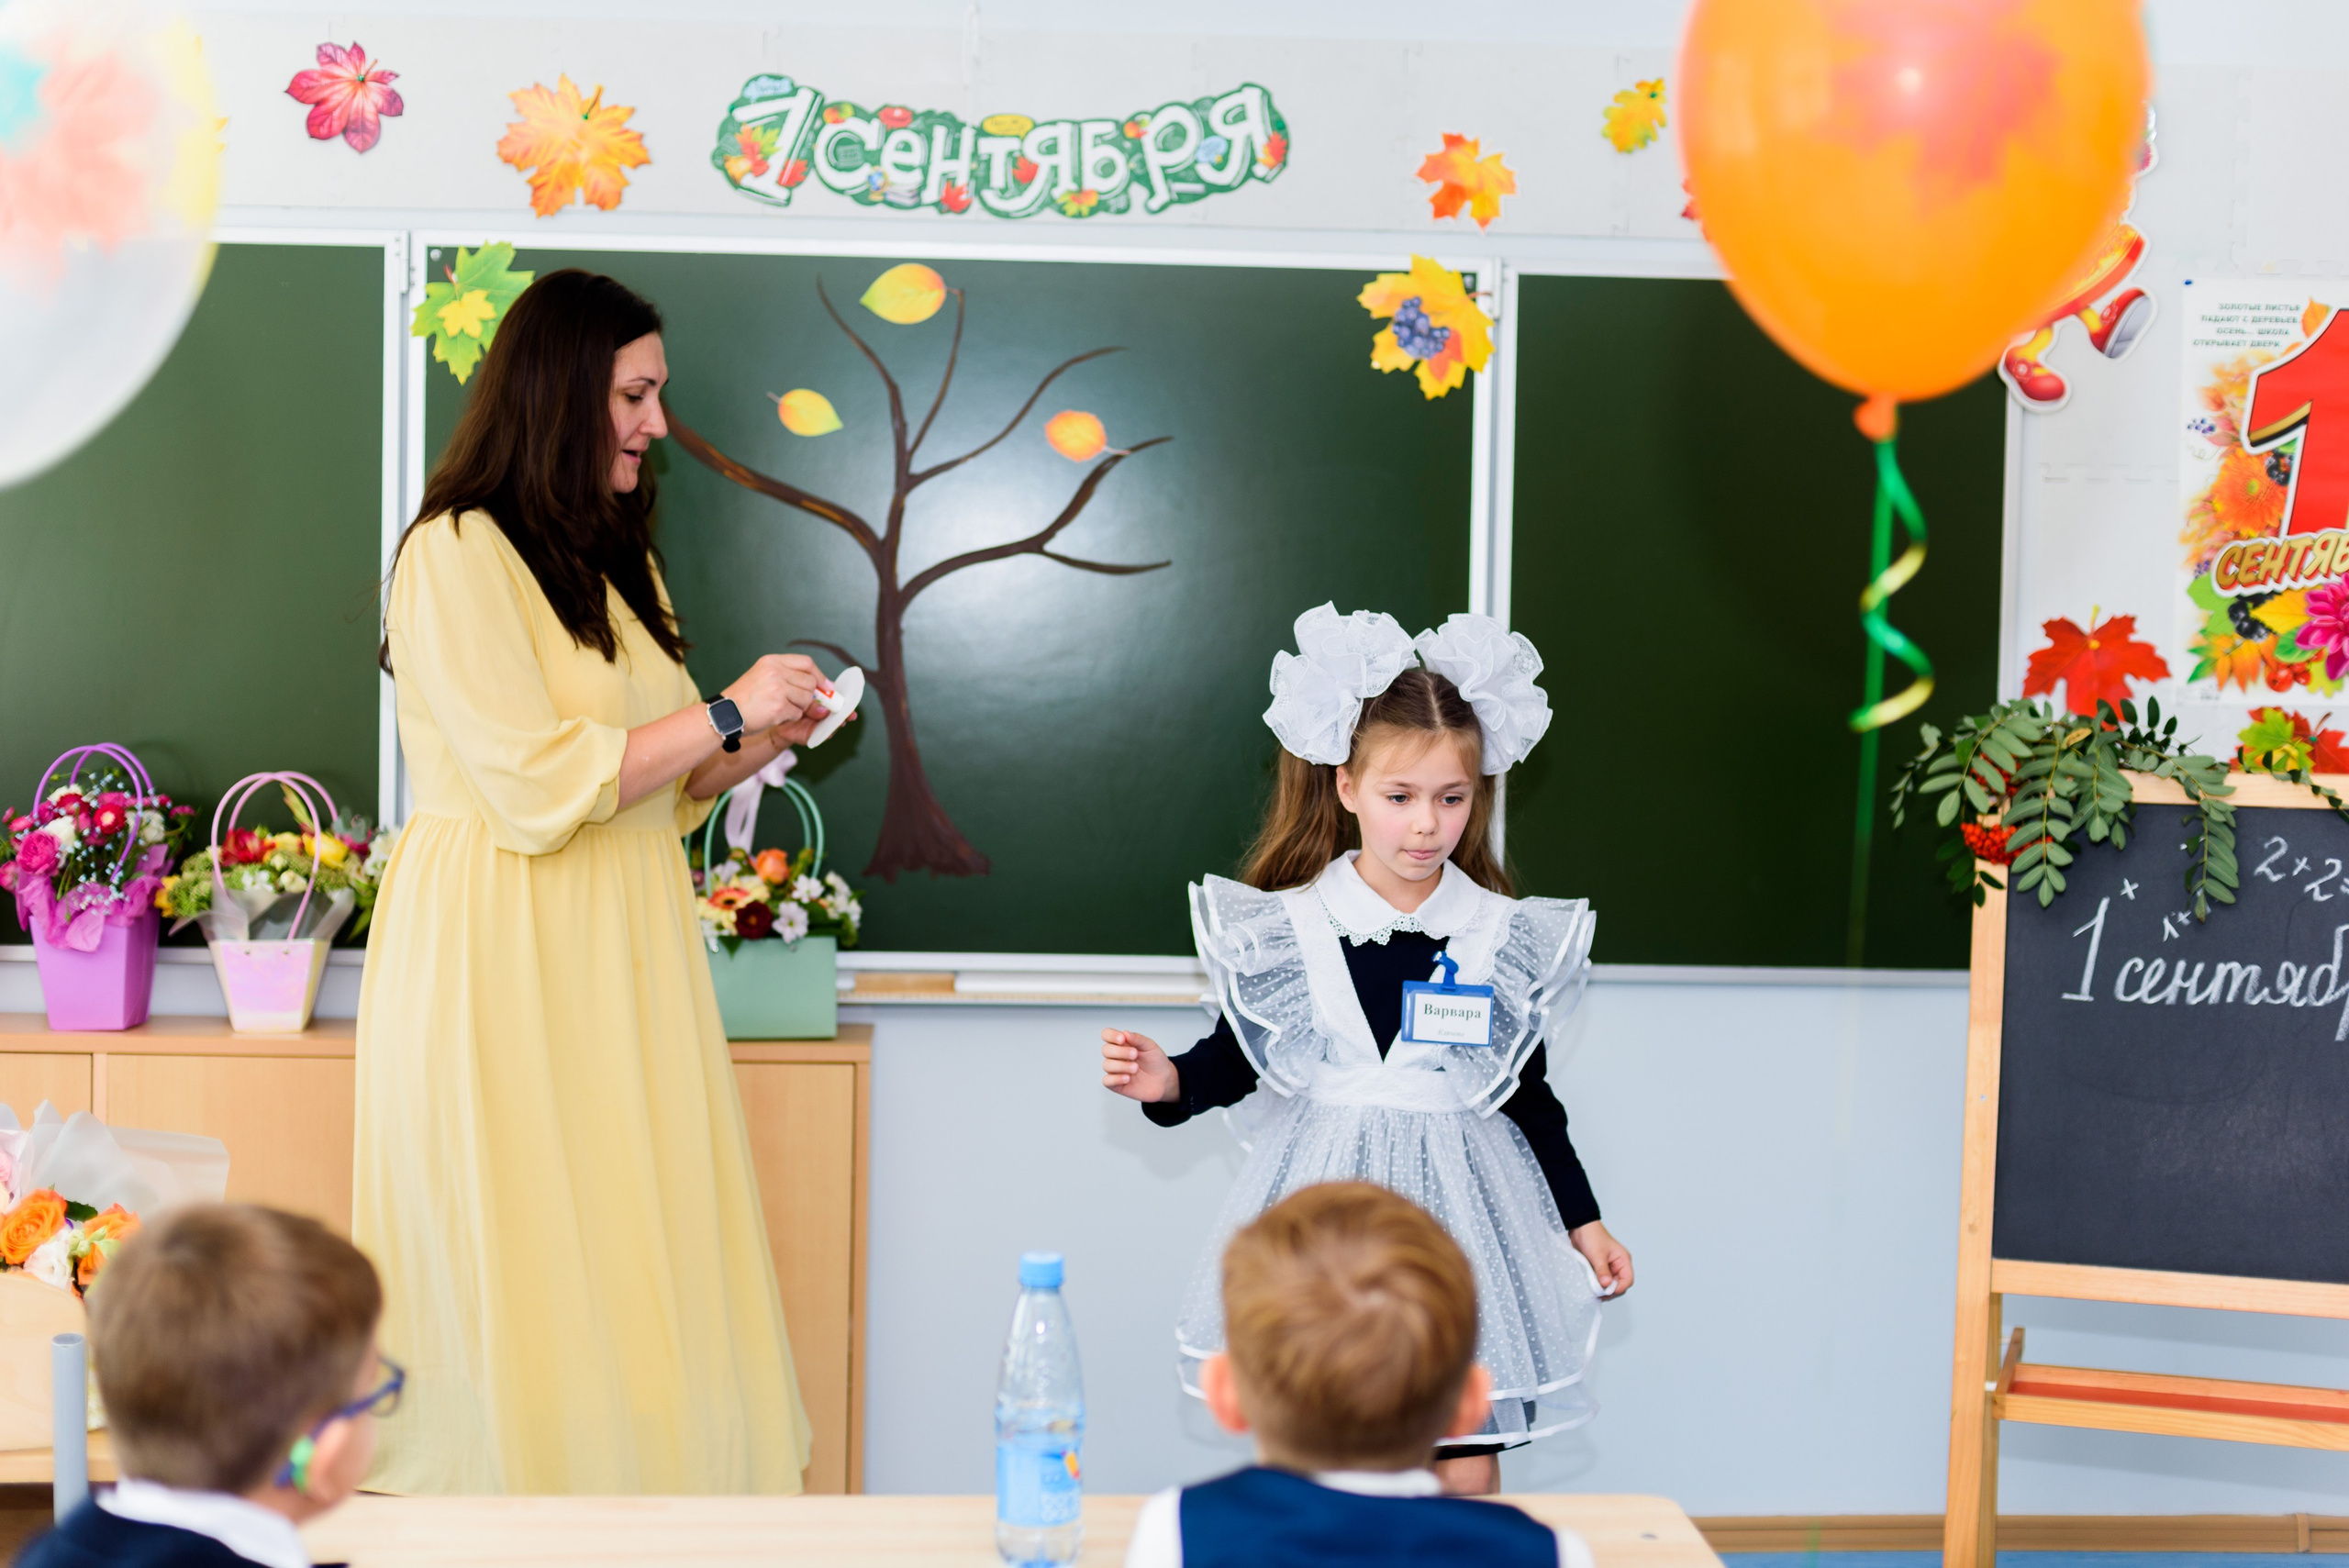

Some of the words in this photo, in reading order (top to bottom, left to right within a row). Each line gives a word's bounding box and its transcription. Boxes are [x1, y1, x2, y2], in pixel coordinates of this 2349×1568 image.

[731, 86, 819, 204] 1
[2219, 303, 2263, 311] ЗОЛОТЫЕ
[2201, 315, 2241, 323] ПАДАЮТ
[2257, 328, 2290, 336] ШКОЛА
[2192, 339, 2247, 347] ОТКРЫВАЕТ
[2061, 895, 2110, 1002] 1
[1424, 1003, 1481, 1021] Варвара
